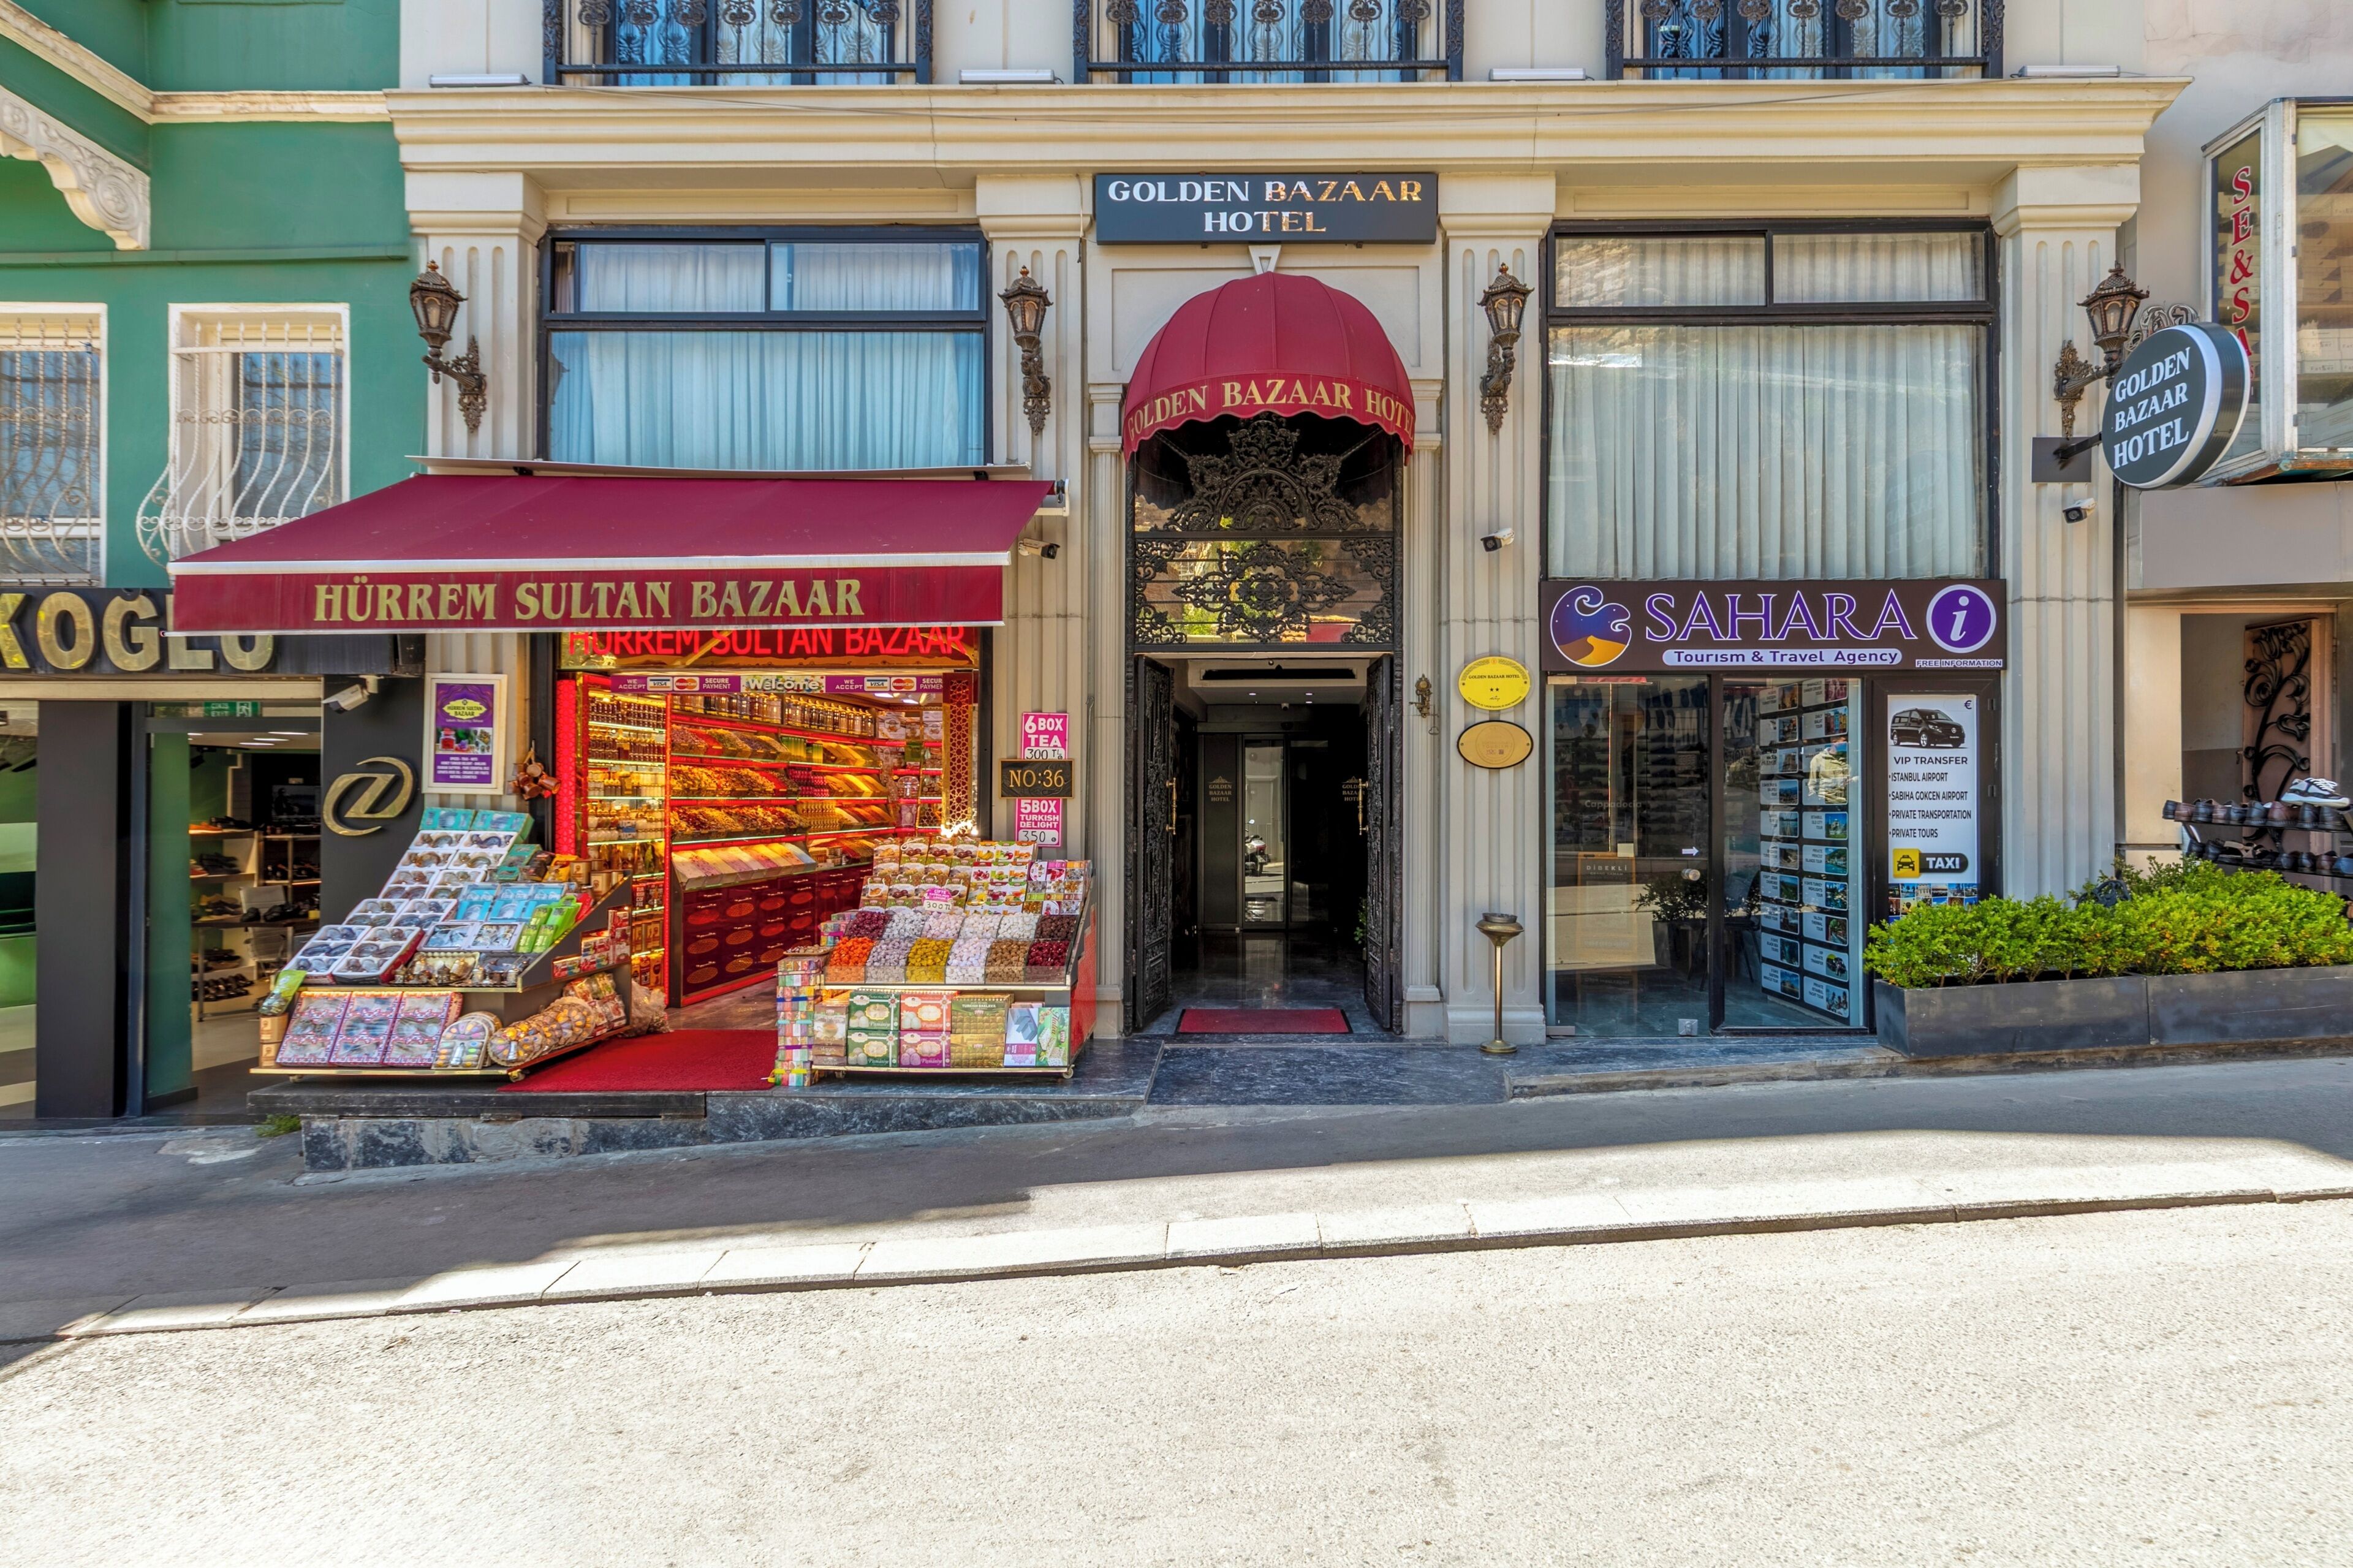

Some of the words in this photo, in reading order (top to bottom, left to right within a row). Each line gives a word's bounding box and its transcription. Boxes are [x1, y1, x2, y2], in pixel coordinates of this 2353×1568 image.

[1108, 181, 1249, 202] GOLDEN
[1265, 181, 1422, 202] BAZAAR
[1203, 211, 1327, 233] HOTEL
[2115, 347, 2191, 403] GOLDEN
[1129, 385, 1208, 441] GOLDEN
[1222, 379, 1353, 409] BAZAAR
[1365, 388, 1415, 441] HOTEL
[2114, 382, 2189, 434] BAZAAR
[2113, 417, 2190, 470] HOTEL
[313, 576, 497, 622] HÜRREM
[515, 581, 672, 620] SULTAN
[691, 579, 865, 618] BAZAAR
[1645, 588, 1919, 642] SAHARA
[845, 626, 968, 654] BAZAAR
[1751, 650, 1764, 662] &
[1769, 650, 1825, 662] Travel
[1833, 650, 1898, 665] Agency
[1916, 659, 1939, 668] FREE
[1941, 659, 2003, 668] INFORMATION
[748, 678, 819, 691] Welcome
[1028, 735, 1062, 747] TEA
[1026, 749, 1048, 760] 300
[1893, 756, 1911, 765] VIP
[1914, 756, 1968, 765] TRANSFER
[1009, 770, 1064, 788] NO:36
[1891, 772, 1920, 782] ISTANBUL
[1922, 772, 1948, 782] AIRPORT
[1891, 791, 1914, 800] SABIHA
[1915, 791, 1940, 800] GOKCEN
[1941, 791, 1968, 800] AIRPORT
[1585, 799, 1642, 809] Cappadocia
[1892, 810, 1917, 819] PRIVATE
[1918, 810, 1971, 819] TRANSPORTATION
[1022, 831, 1046, 843] 350
[1892, 828, 1917, 838] PRIVATE
[1918, 828, 1938, 838] TOURS
[1926, 857, 1960, 869] TAXI
